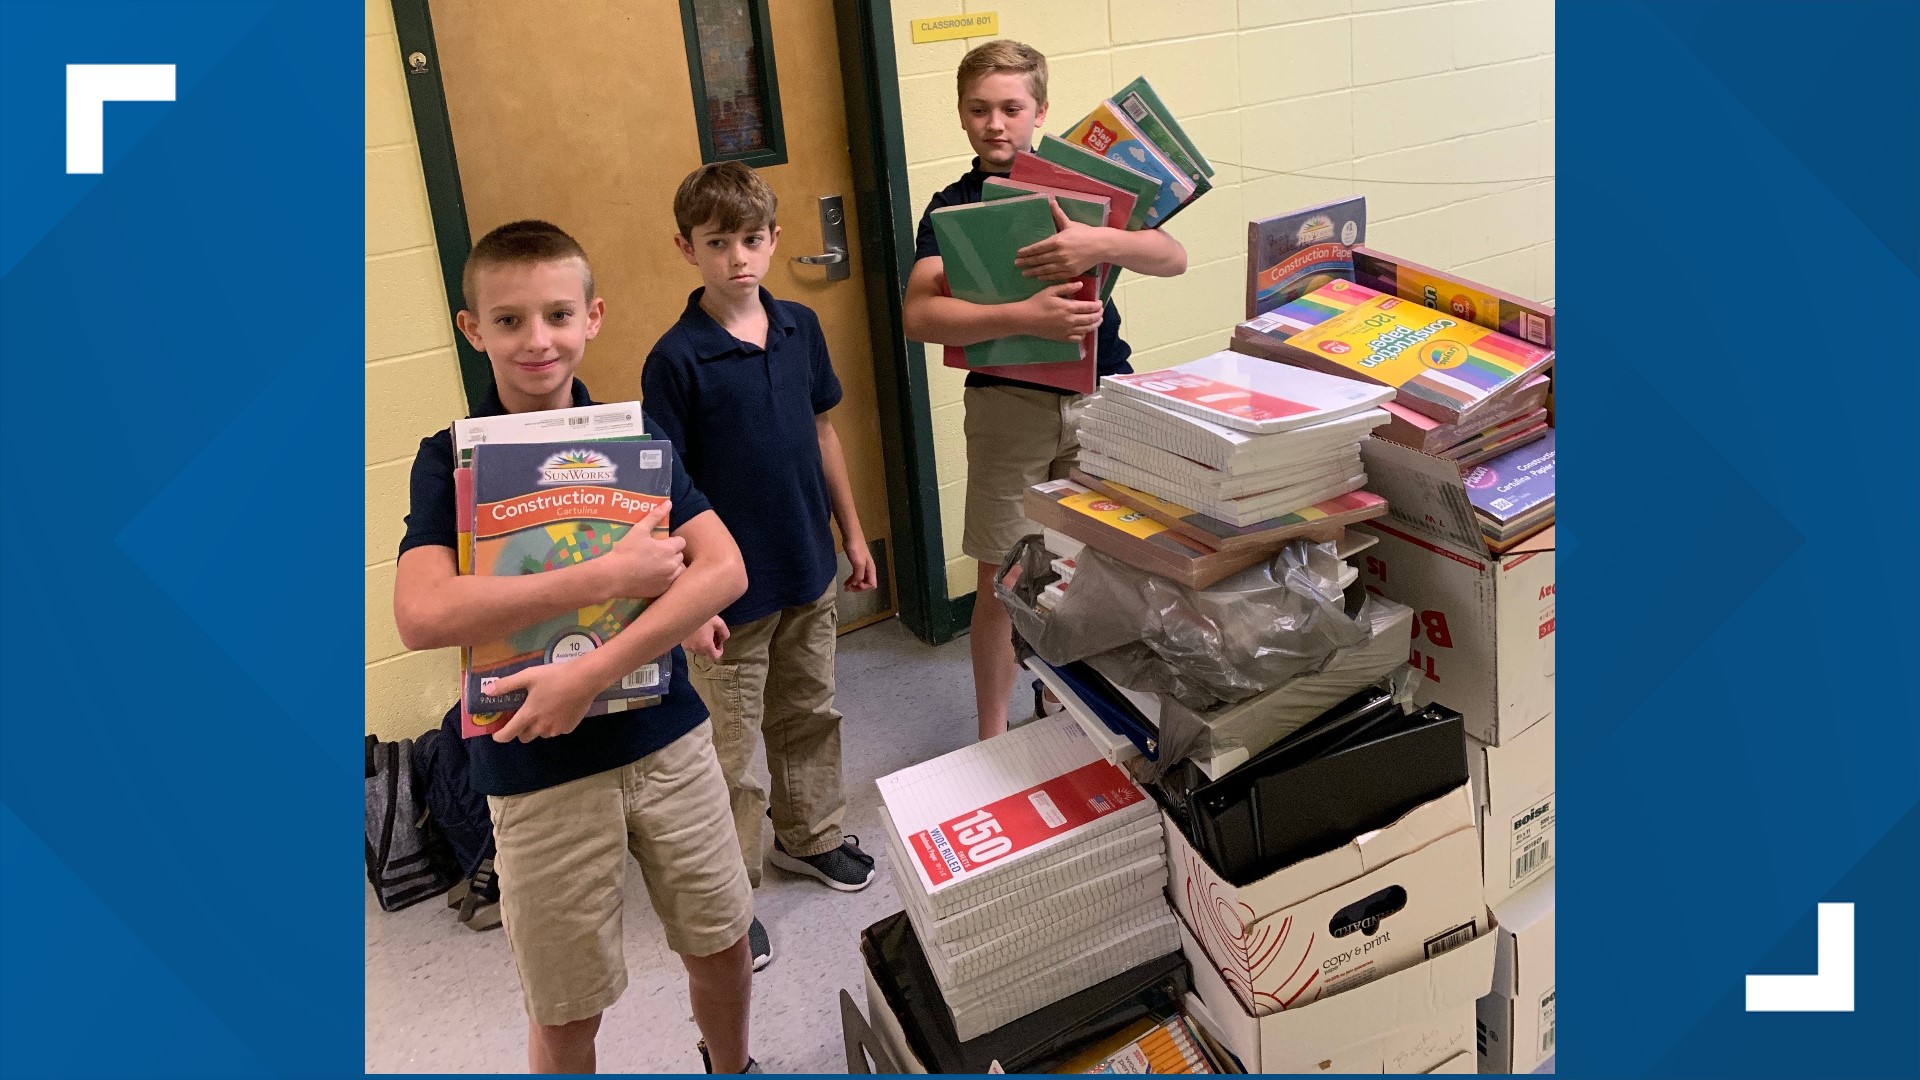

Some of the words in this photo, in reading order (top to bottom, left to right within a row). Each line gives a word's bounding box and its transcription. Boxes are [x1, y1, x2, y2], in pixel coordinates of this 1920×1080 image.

[921, 18, 973, 31] CLASSROOM
[1087, 134, 1106, 150] Day
[1092, 125, 1112, 144] Play
[1271, 247, 1329, 281] Construction
[1331, 245, 1352, 261] Pape
[1453, 302, 1464, 313] 8
[1364, 312, 1397, 328] 120
[1357, 319, 1457, 368] Construction
[1366, 324, 1414, 351] paper
[1331, 345, 1350, 354] 10
[1496, 475, 1531, 493] Cartulina
[491, 488, 605, 521] Construction
[611, 492, 657, 514] Paper
[556, 507, 598, 516] Cartulina
[569, 642, 580, 651] 10
[951, 809, 1013, 863] 150
[930, 827, 948, 849] WIDE
[941, 847, 961, 873] RULED
[957, 850, 971, 868] SHEETS
[1322, 949, 1353, 969] copy
[1354, 946, 1361, 956] &
[1363, 931, 1391, 955] print
